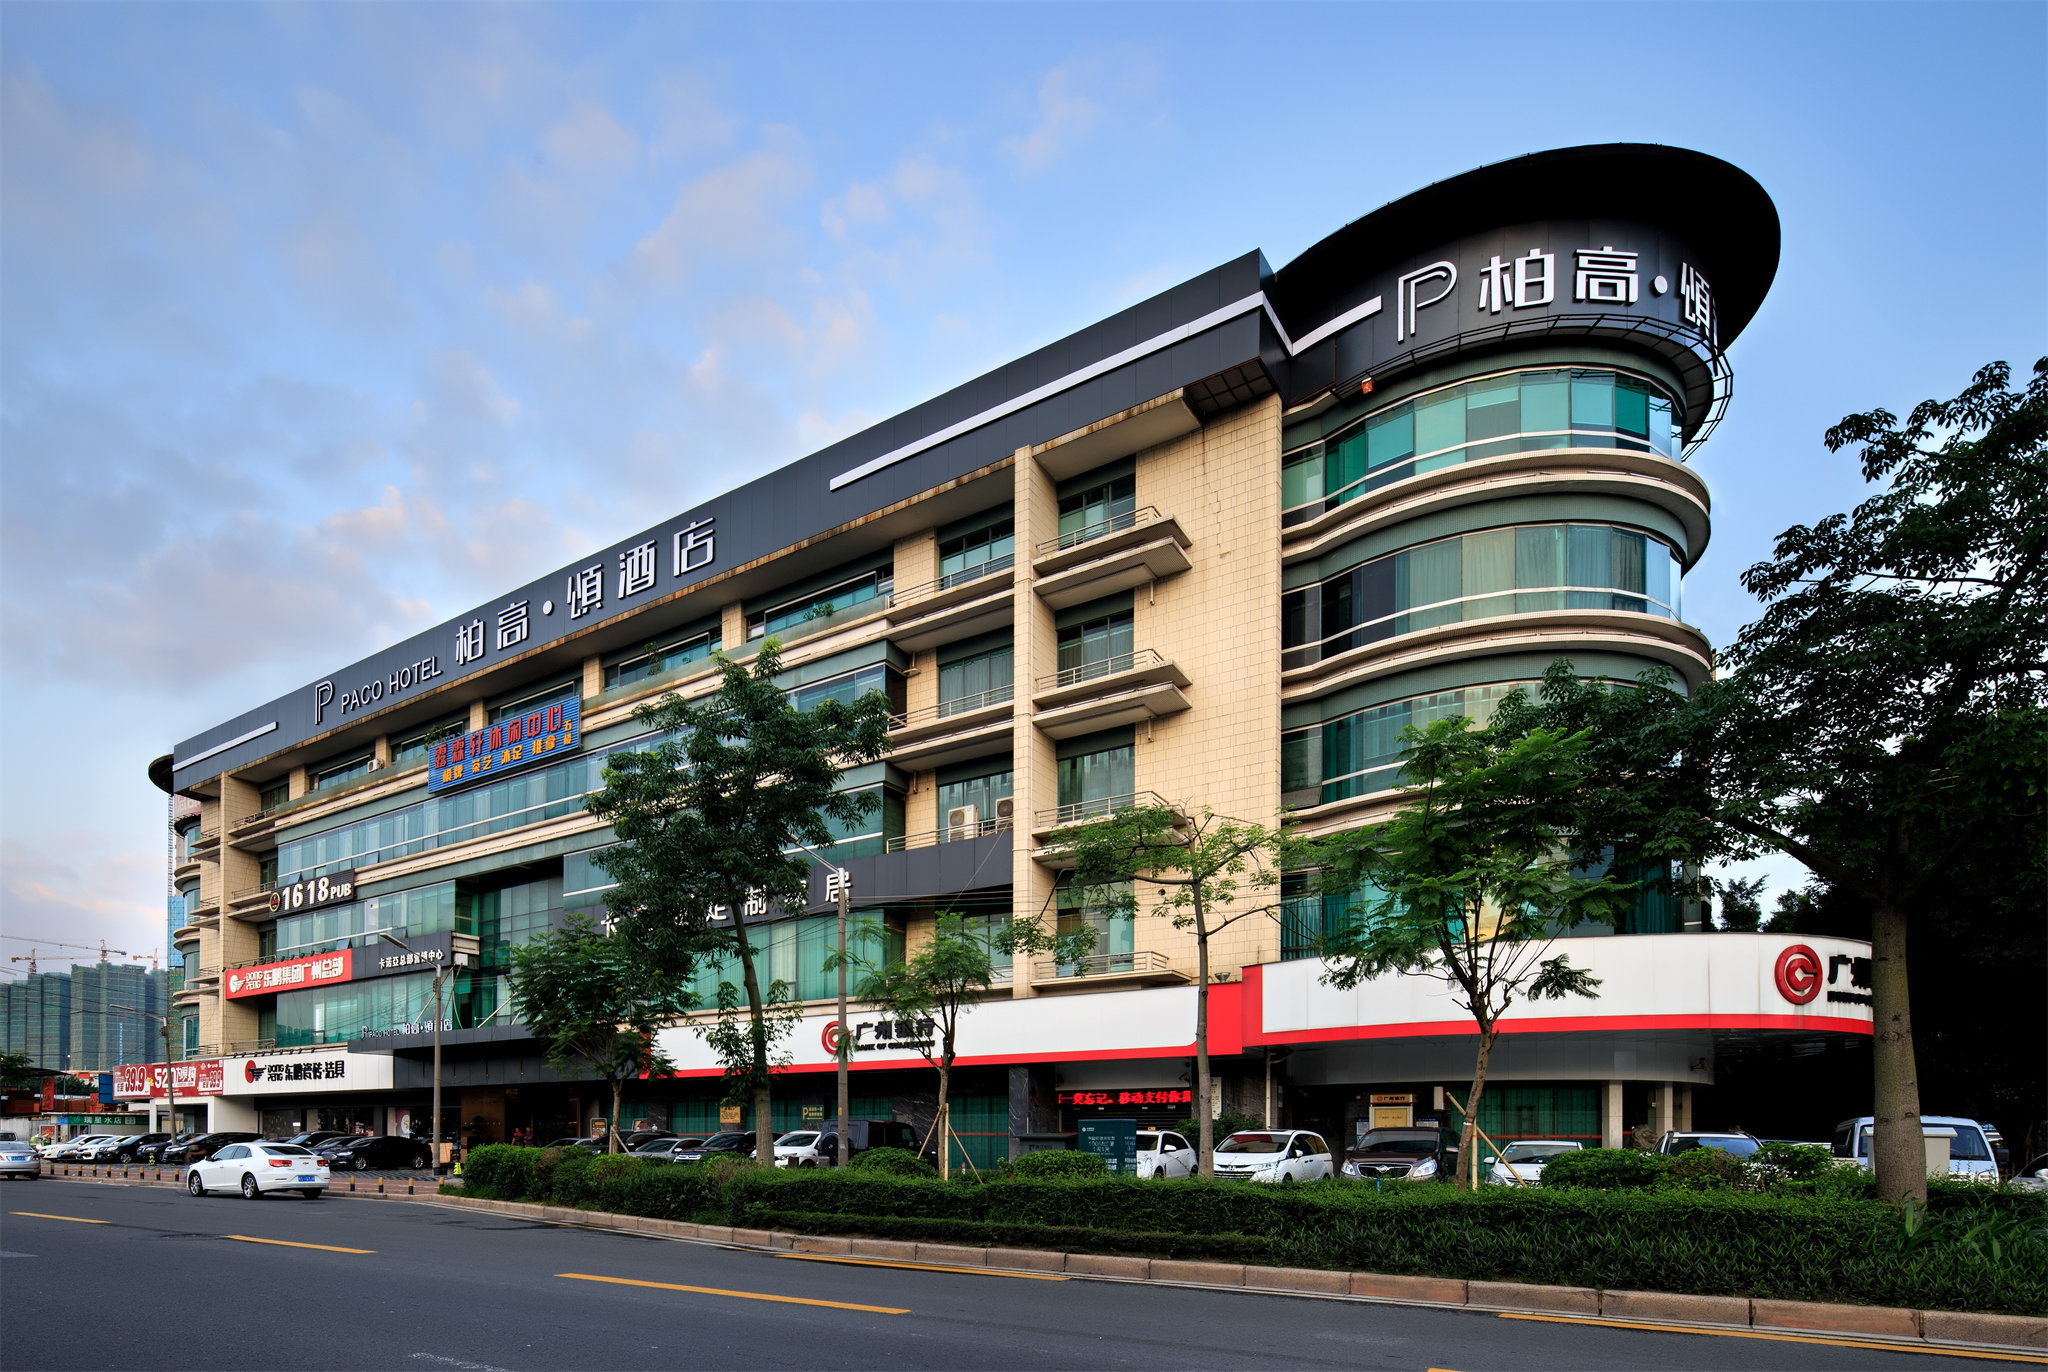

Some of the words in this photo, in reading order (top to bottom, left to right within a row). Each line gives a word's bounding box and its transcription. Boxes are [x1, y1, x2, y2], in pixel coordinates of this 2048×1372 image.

[341, 680, 383, 714] PACO
[389, 656, 442, 694] HOTEL
[472, 755, 492, 773] 茶艺
[501, 744, 523, 765] 沐足
[282, 877, 330, 910] 1618
[330, 883, 351, 899] PUB
[263, 956, 344, 988] 东鹏集团广州总部
[402, 1018, 453, 1035] 柏高·頌店
